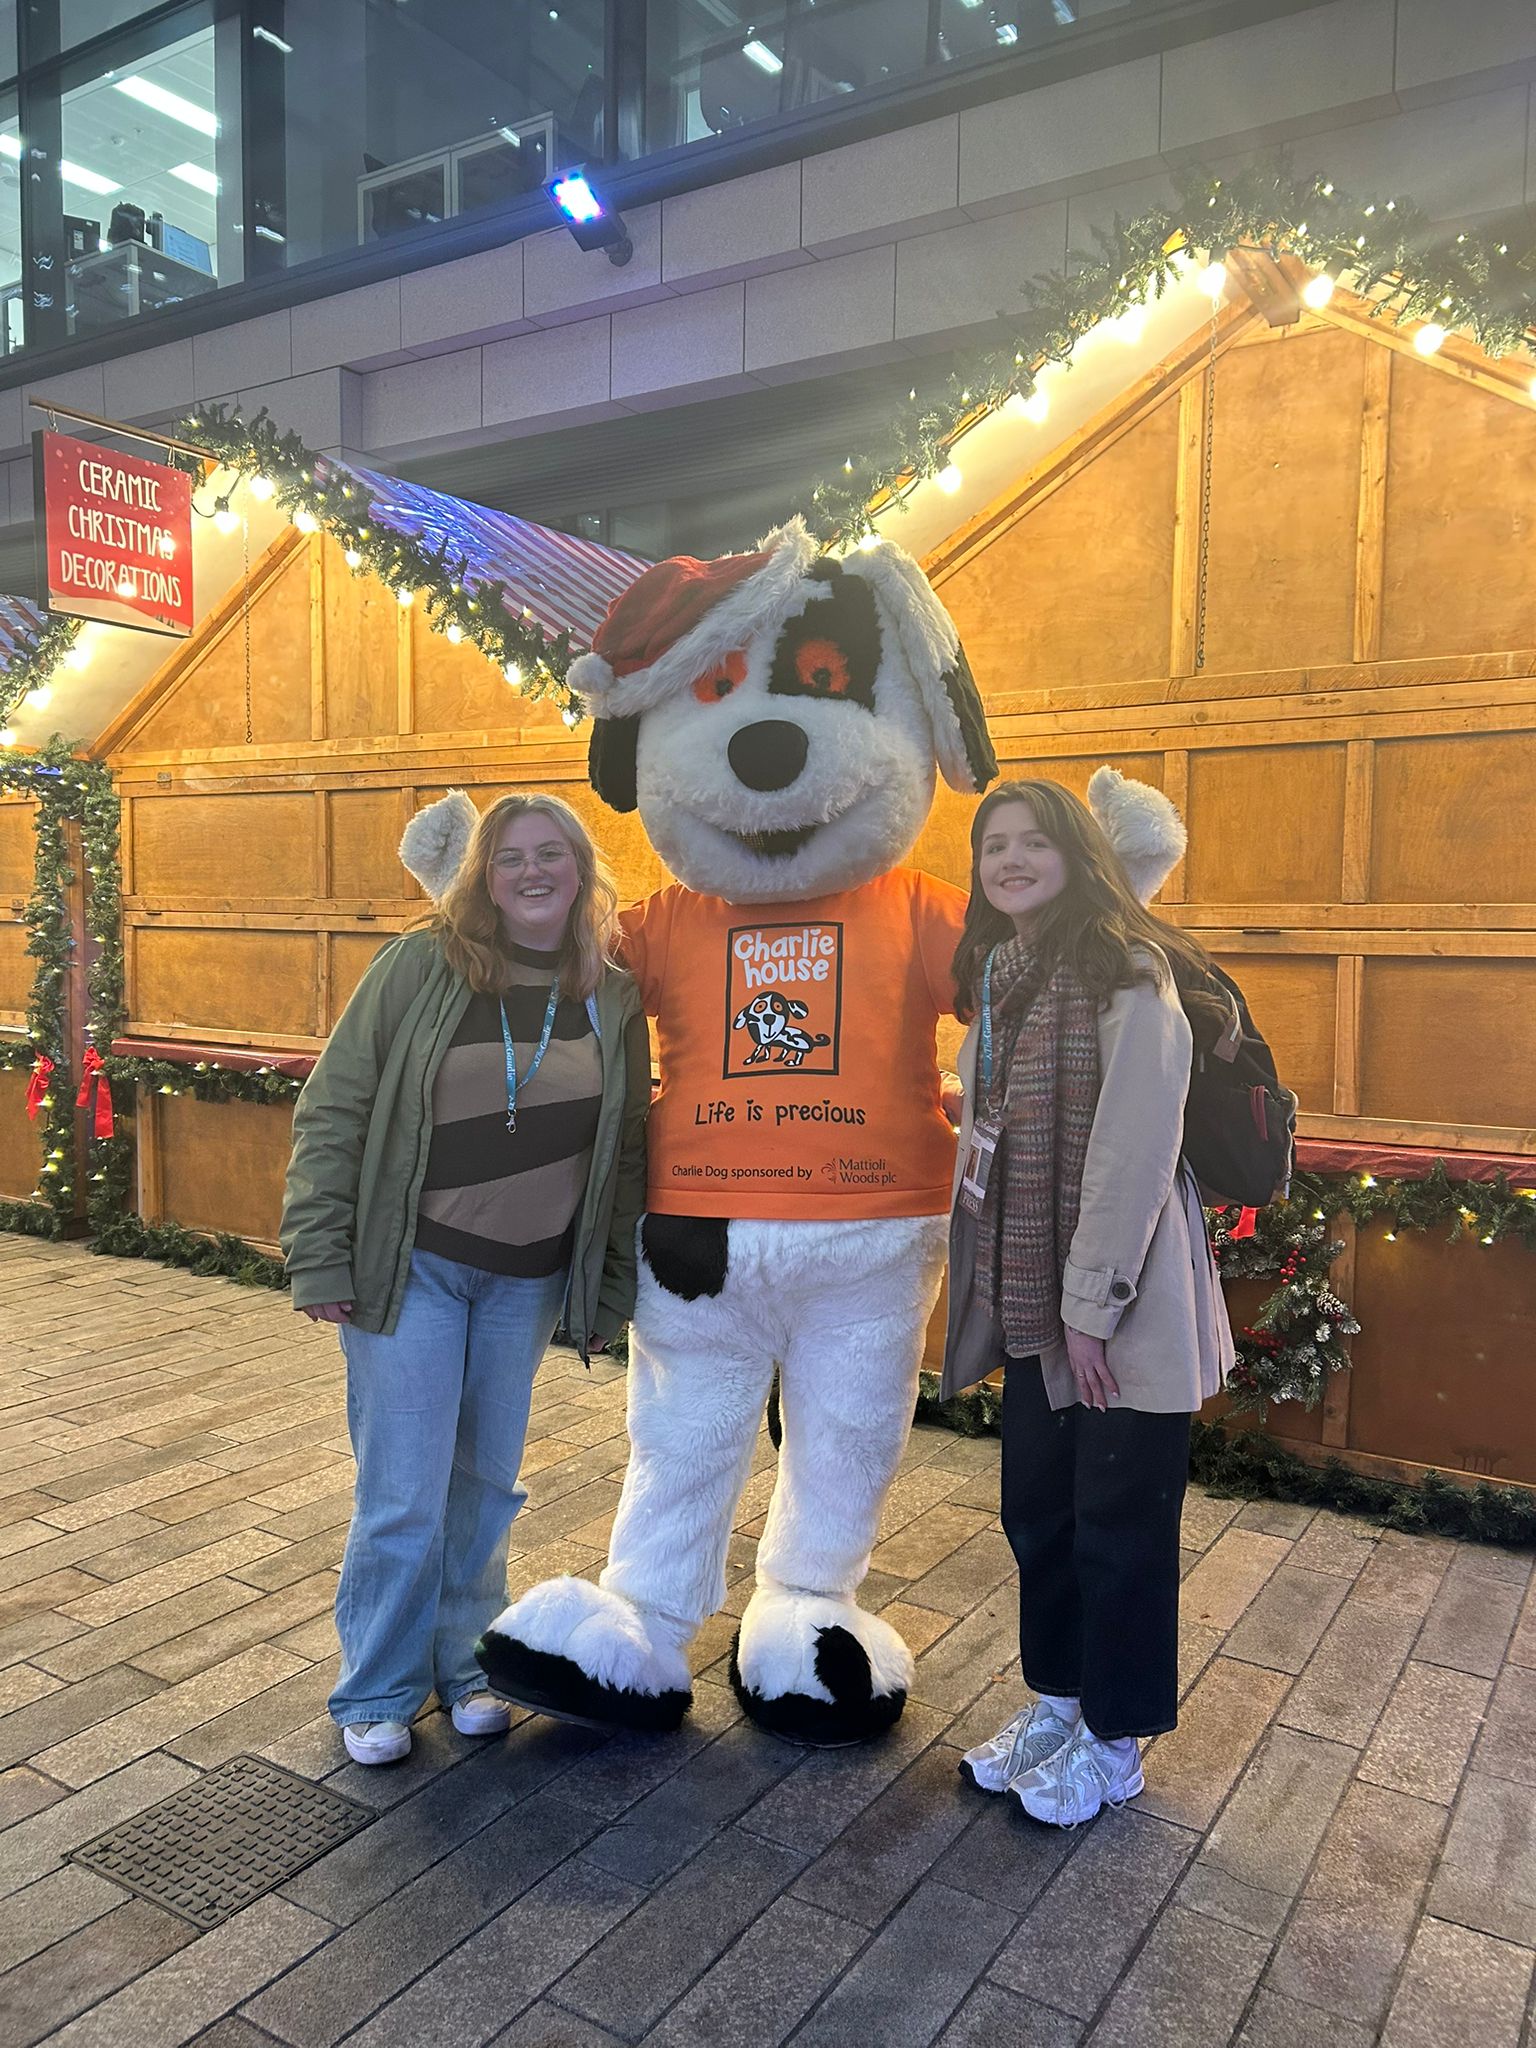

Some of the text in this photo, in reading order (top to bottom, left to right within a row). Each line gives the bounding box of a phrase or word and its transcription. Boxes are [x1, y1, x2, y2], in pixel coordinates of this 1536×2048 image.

[79, 459, 162, 512] CERAMIC
[61, 550, 182, 607] DECORATIONS
[734, 928, 835, 962] Charlie
[743, 958, 829, 988] house
[694, 1099, 866, 1126] Life is precious
[672, 1165, 813, 1180] Charlie Dog sponsored by
[839, 1158, 886, 1171] Mattioli
[839, 1172, 897, 1186] Woods plc
[1033, 1733, 1055, 1755] N
